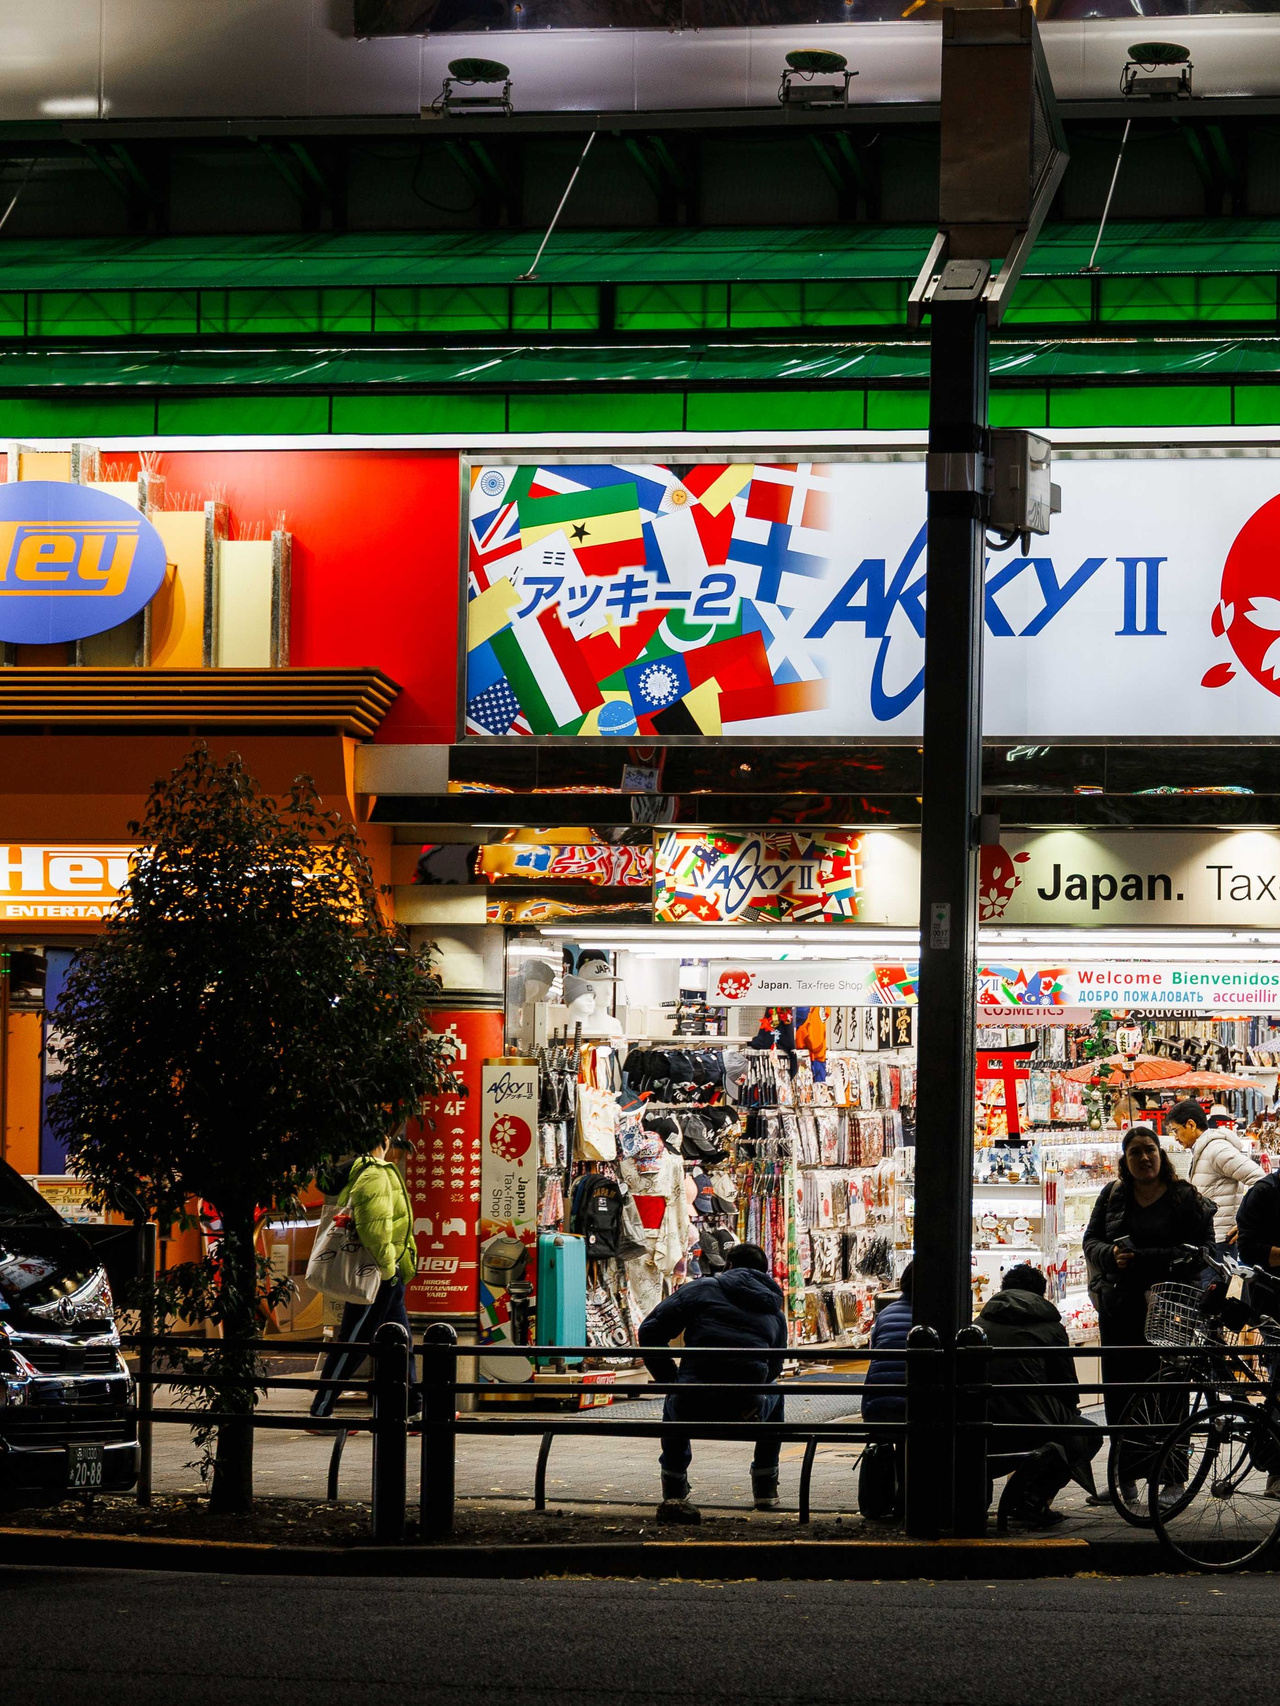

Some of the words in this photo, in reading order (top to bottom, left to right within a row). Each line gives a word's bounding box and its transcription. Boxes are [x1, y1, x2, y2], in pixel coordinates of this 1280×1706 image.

[0, 520, 141, 597] ey
[518, 573, 737, 619] アッキー2
[1037, 863, 1184, 910] Japan.
[757, 980, 792, 992] Japan.
[796, 980, 835, 990] Tax-free
[838, 980, 863, 992] Shop
[1078, 970, 1162, 984] Welcome
[1172, 971, 1280, 986] Bienvenidos
[1078, 990, 1119, 1003] ДОБРО
[1123, 990, 1204, 1003] ПОЖАЛОВАТЬ
[1213, 990, 1278, 1003] accueillir
[443, 1101, 466, 1116] 4F
[492, 1189, 503, 1218] Shop
[504, 1172, 514, 1218] Tax-free
[516, 1177, 527, 1217] Japan.
[417, 1257, 459, 1274] Hey
